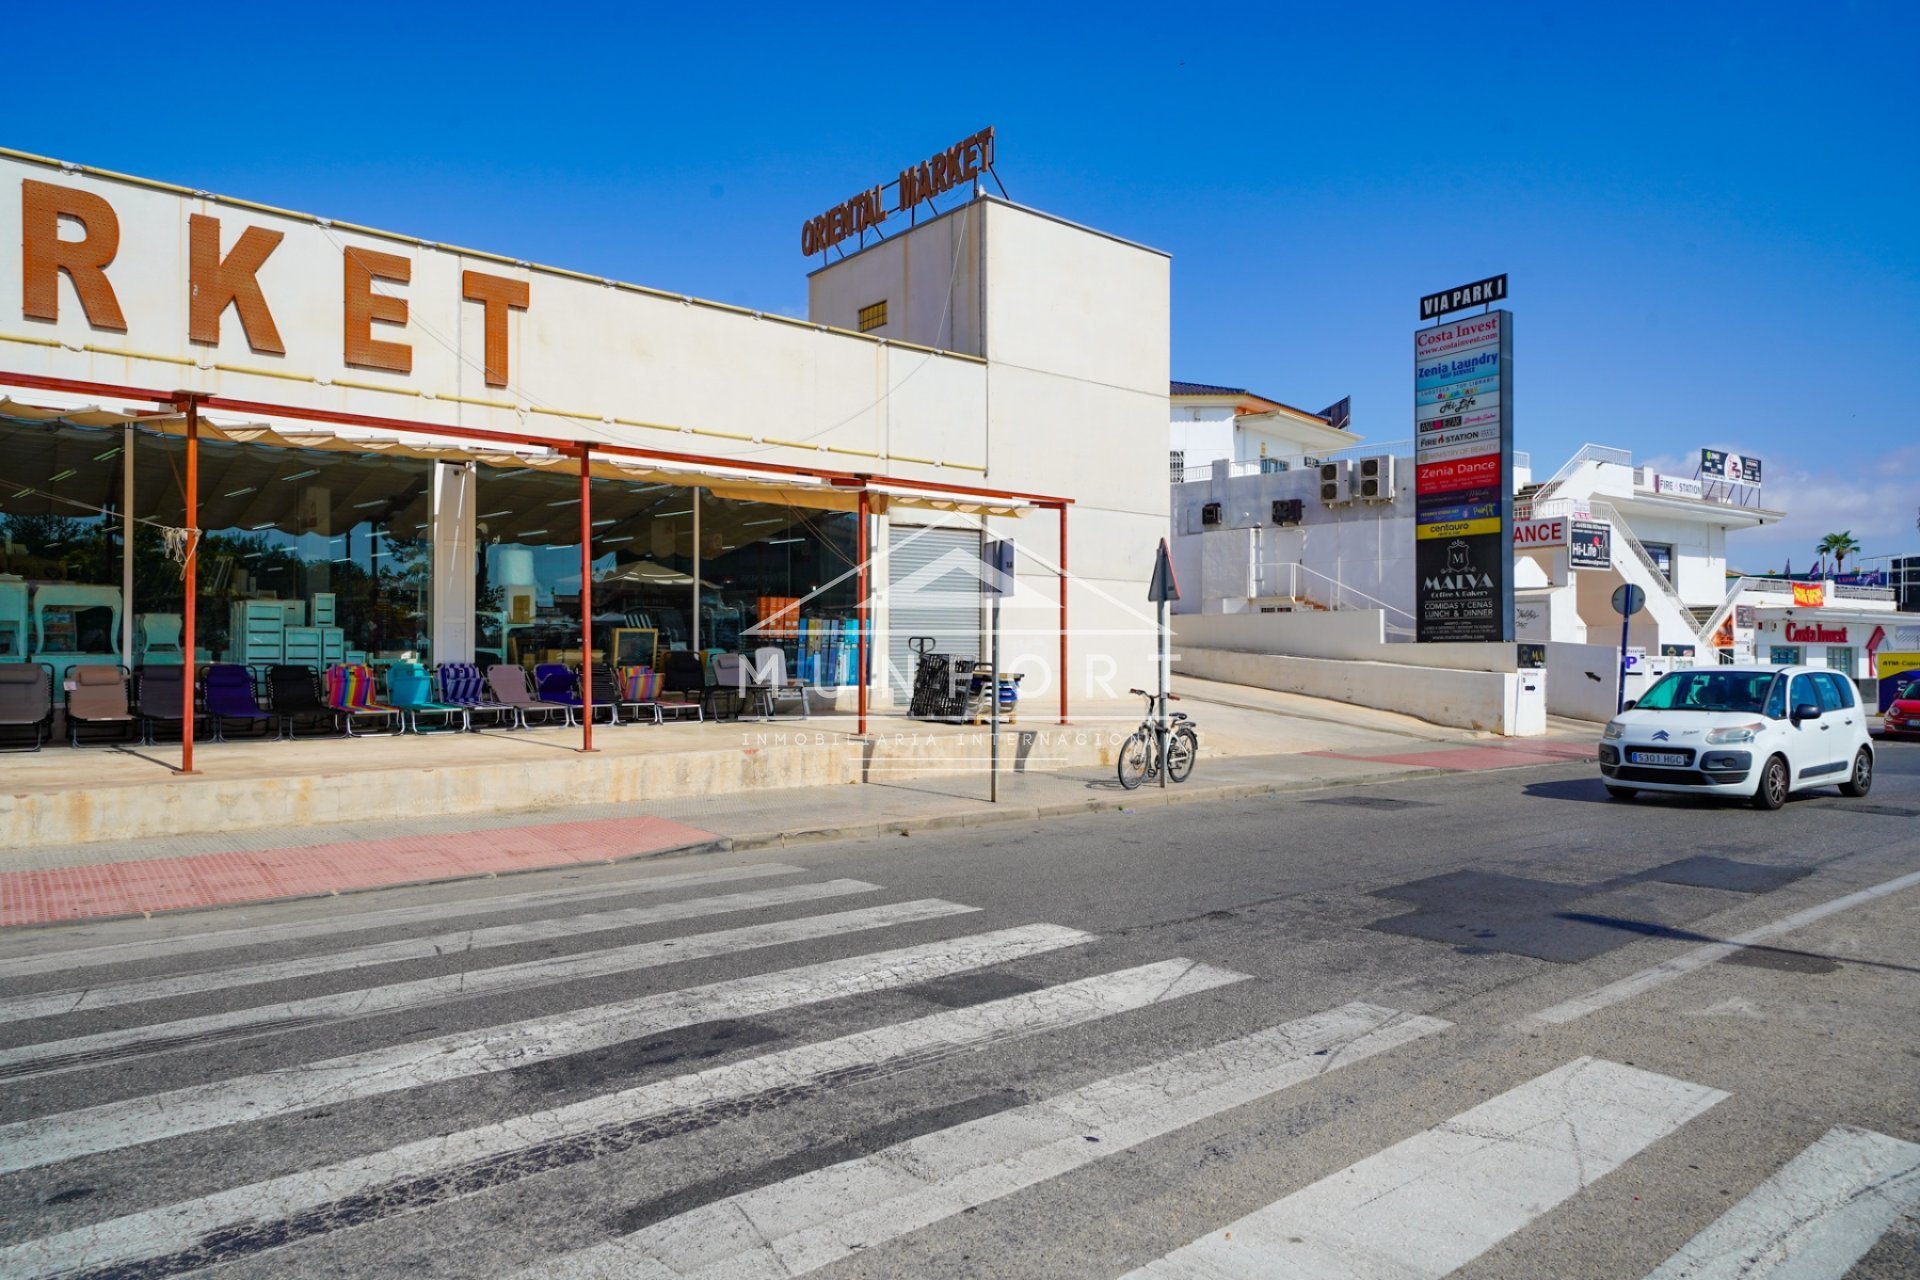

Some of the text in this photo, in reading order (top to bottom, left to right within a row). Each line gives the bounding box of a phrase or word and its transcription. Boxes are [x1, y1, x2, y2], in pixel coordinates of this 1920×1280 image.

[802, 125, 994, 256] ORIENTAL MARKET
[22, 178, 529, 387] RKET
[1424, 279, 1503, 315] VIA PARK I
[1417, 318, 1497, 347] Costa Invest
[1418, 352, 1498, 378] Zenia Laundry
[1421, 437, 1437, 447] FIRE
[1446, 431, 1479, 443] STATION
[1421, 461, 1496, 479] Zenia Dance
[1430, 523, 1469, 532] centauro
[1572, 542, 1597, 556] Hi-Life
[1452, 553, 1464, 564] M
[1423, 572, 1494, 591] MALVA
[1424, 602, 1459, 610] COMIDAS
[1467, 600, 1493, 609] CENAS
[1424, 610, 1450, 618] LUNCH
[1463, 608, 1493, 617] DINNER
[1785, 622, 1848, 643] Costa Invest
[1625, 656, 1637, 669] P
